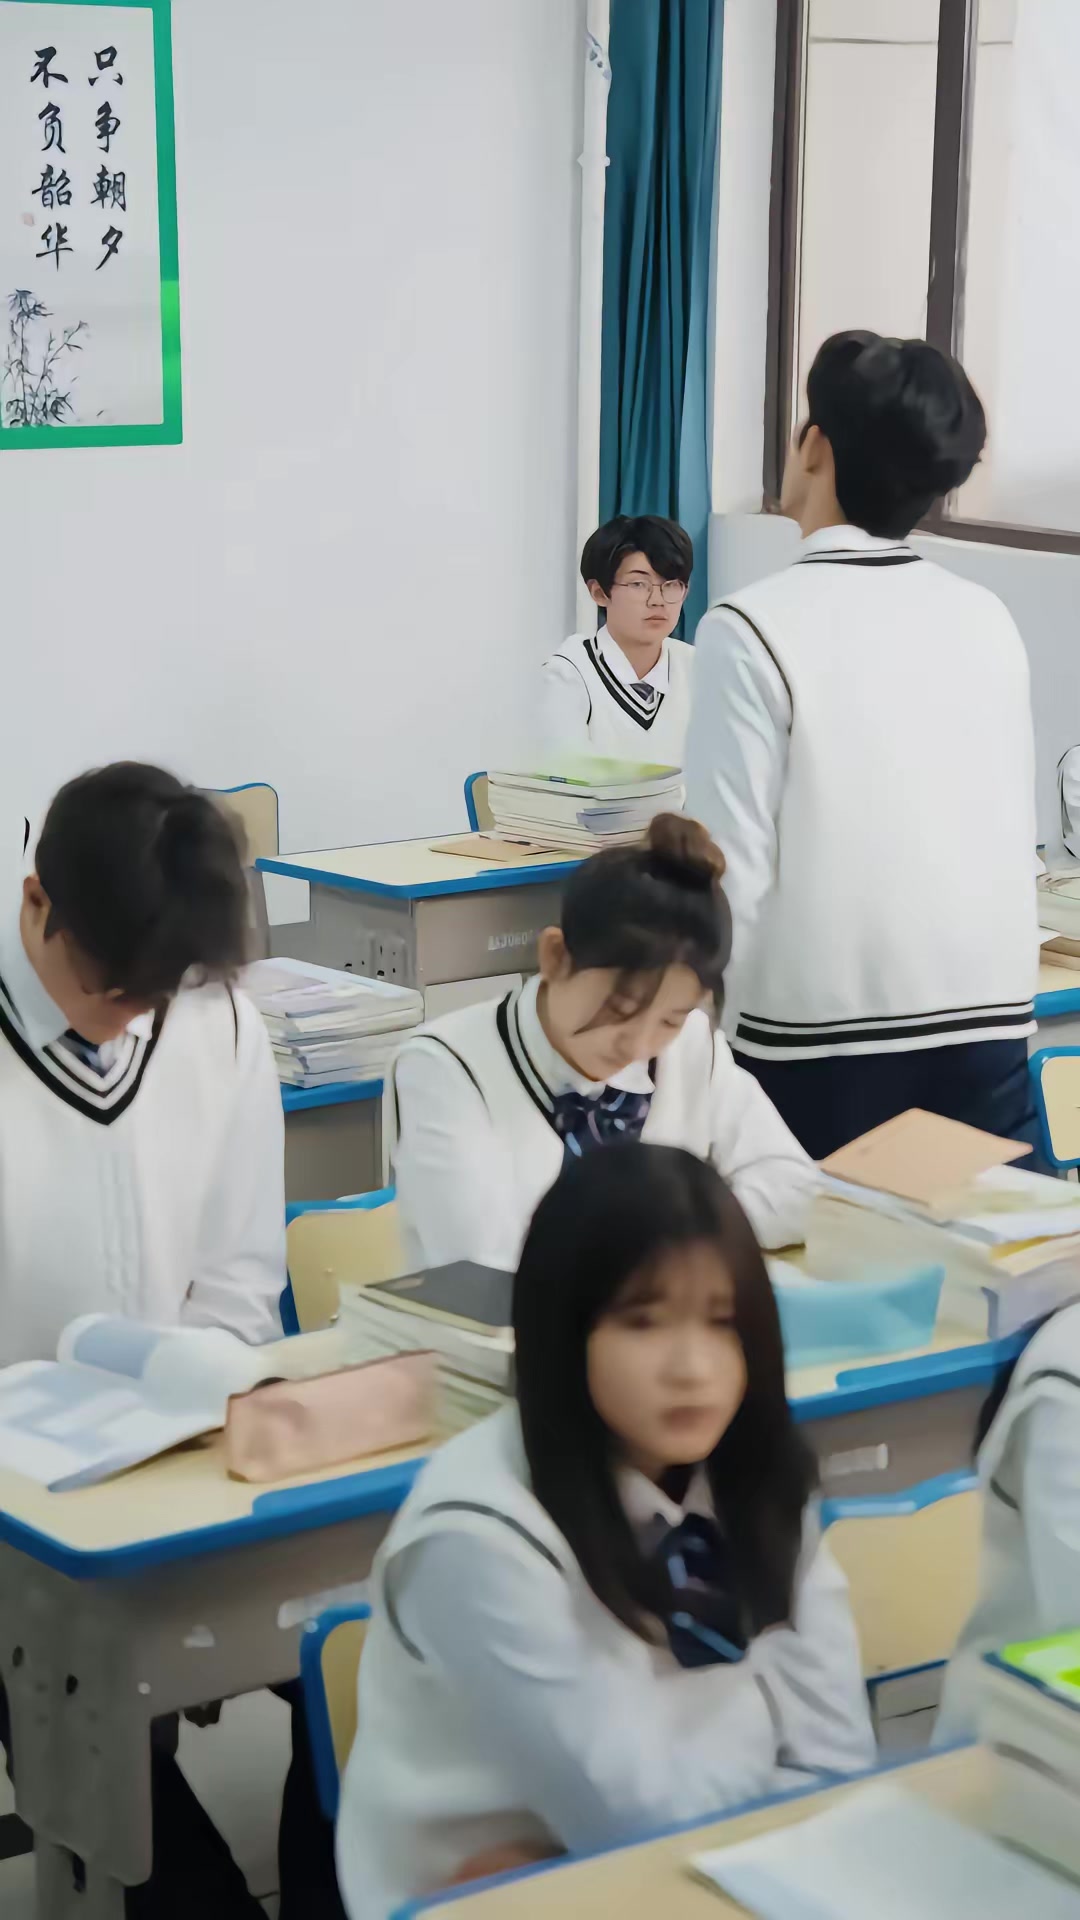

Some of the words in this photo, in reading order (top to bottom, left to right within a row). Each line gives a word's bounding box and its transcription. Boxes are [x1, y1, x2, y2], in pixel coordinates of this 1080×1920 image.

[30, 45, 74, 271] 不负韶华
[88, 45, 127, 271] 只争朝夕
